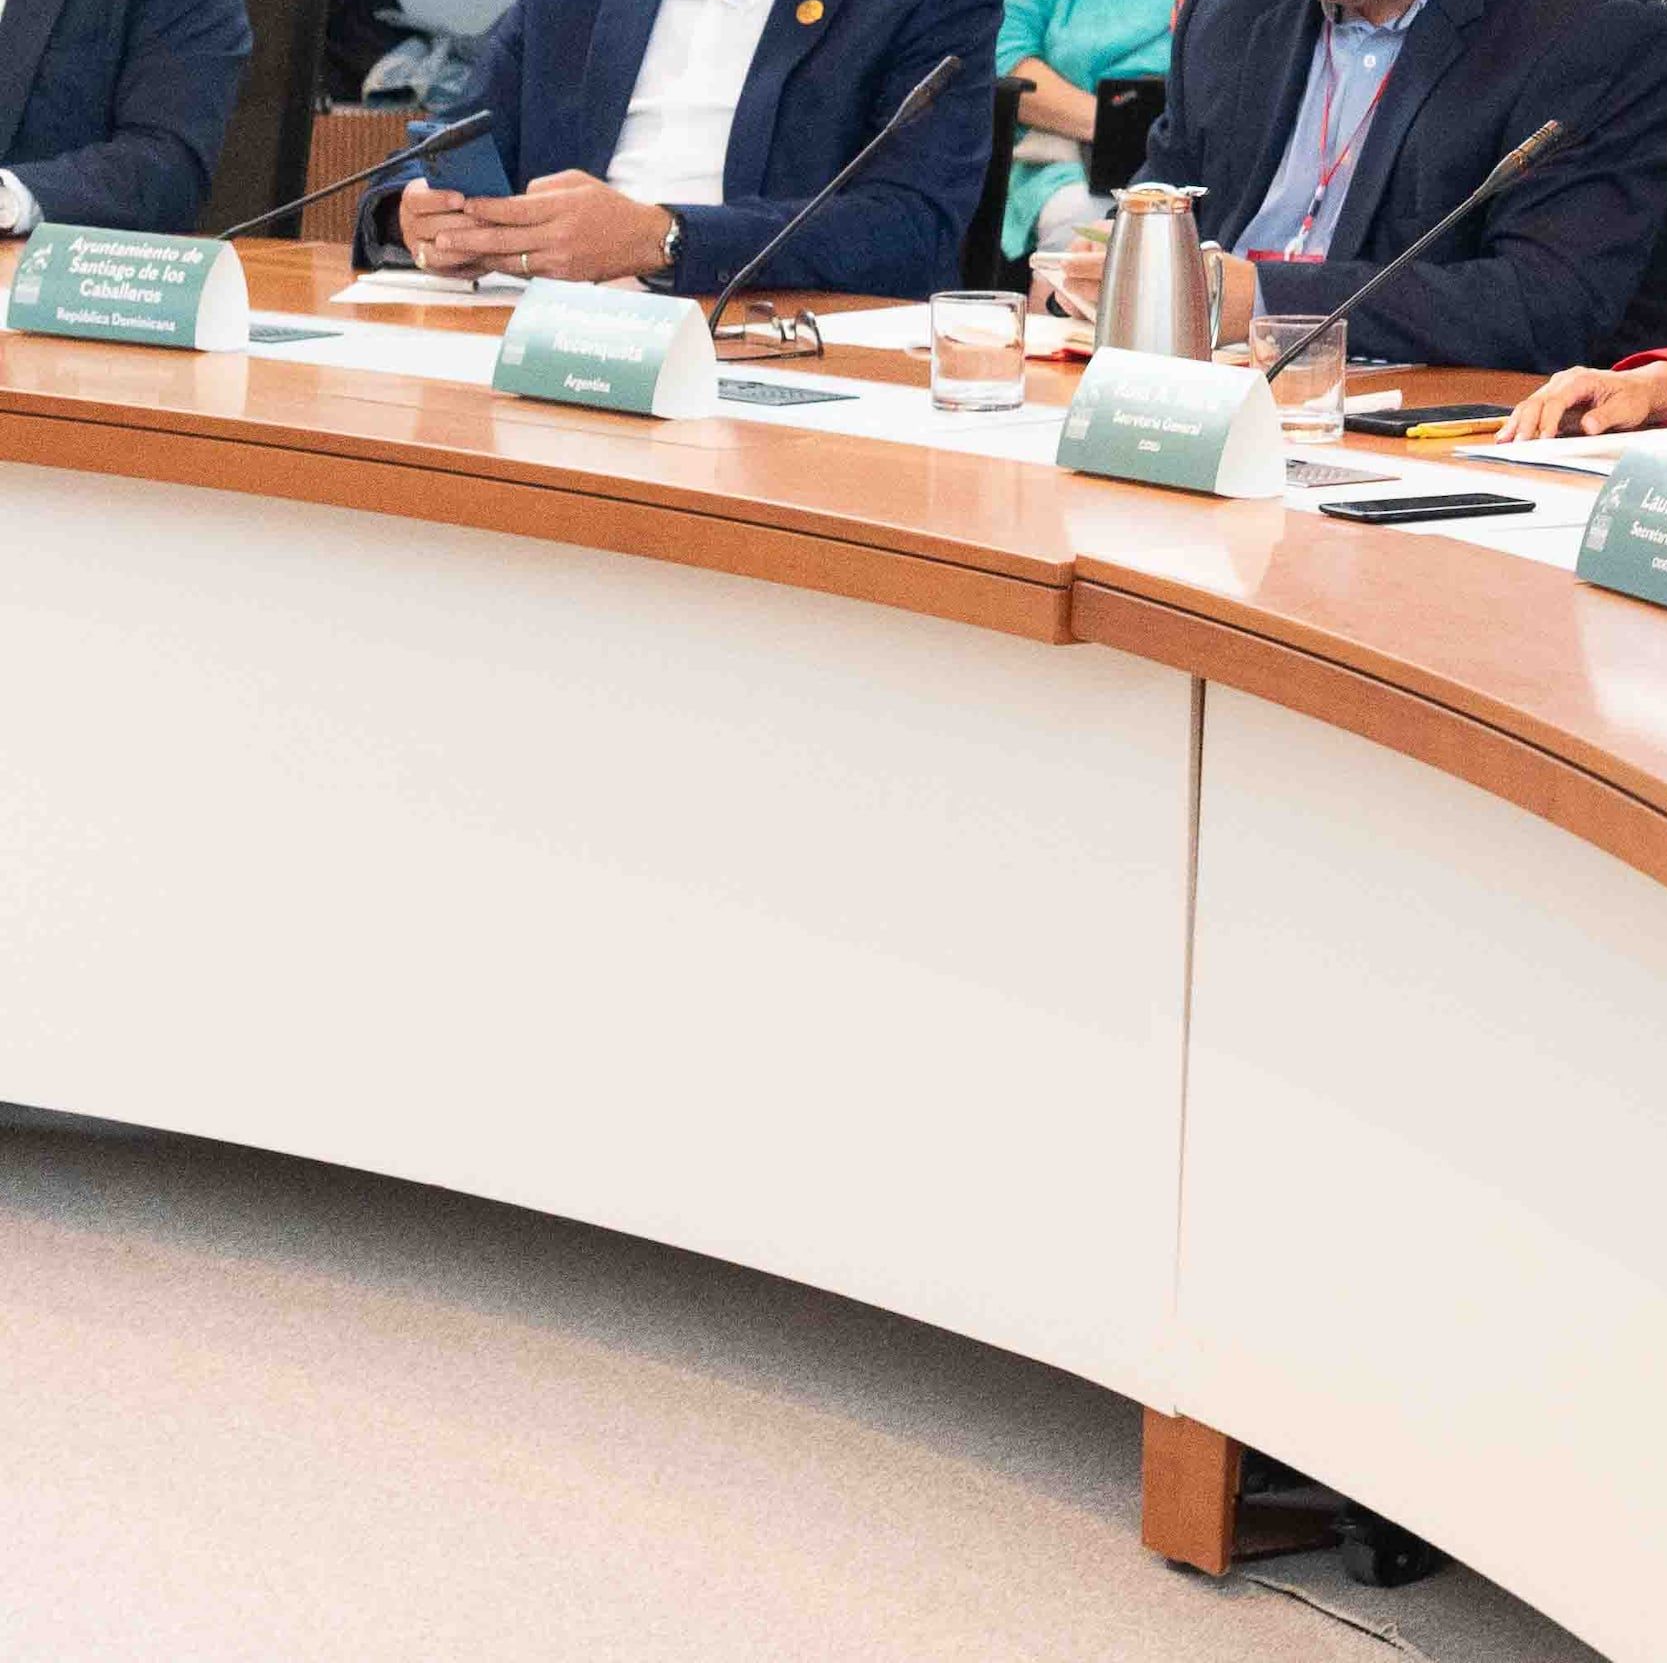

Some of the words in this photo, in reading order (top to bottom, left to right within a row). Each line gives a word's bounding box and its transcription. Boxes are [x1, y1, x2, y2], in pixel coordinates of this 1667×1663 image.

[68, 236, 180, 262] Ayuntamiento
[182, 247, 204, 264] de
[69, 257, 135, 281] Santiago
[138, 262, 160, 281] de
[162, 265, 186, 284] los
[79, 279, 163, 304] Caballeros
[111, 311, 177, 332] Dominicana
